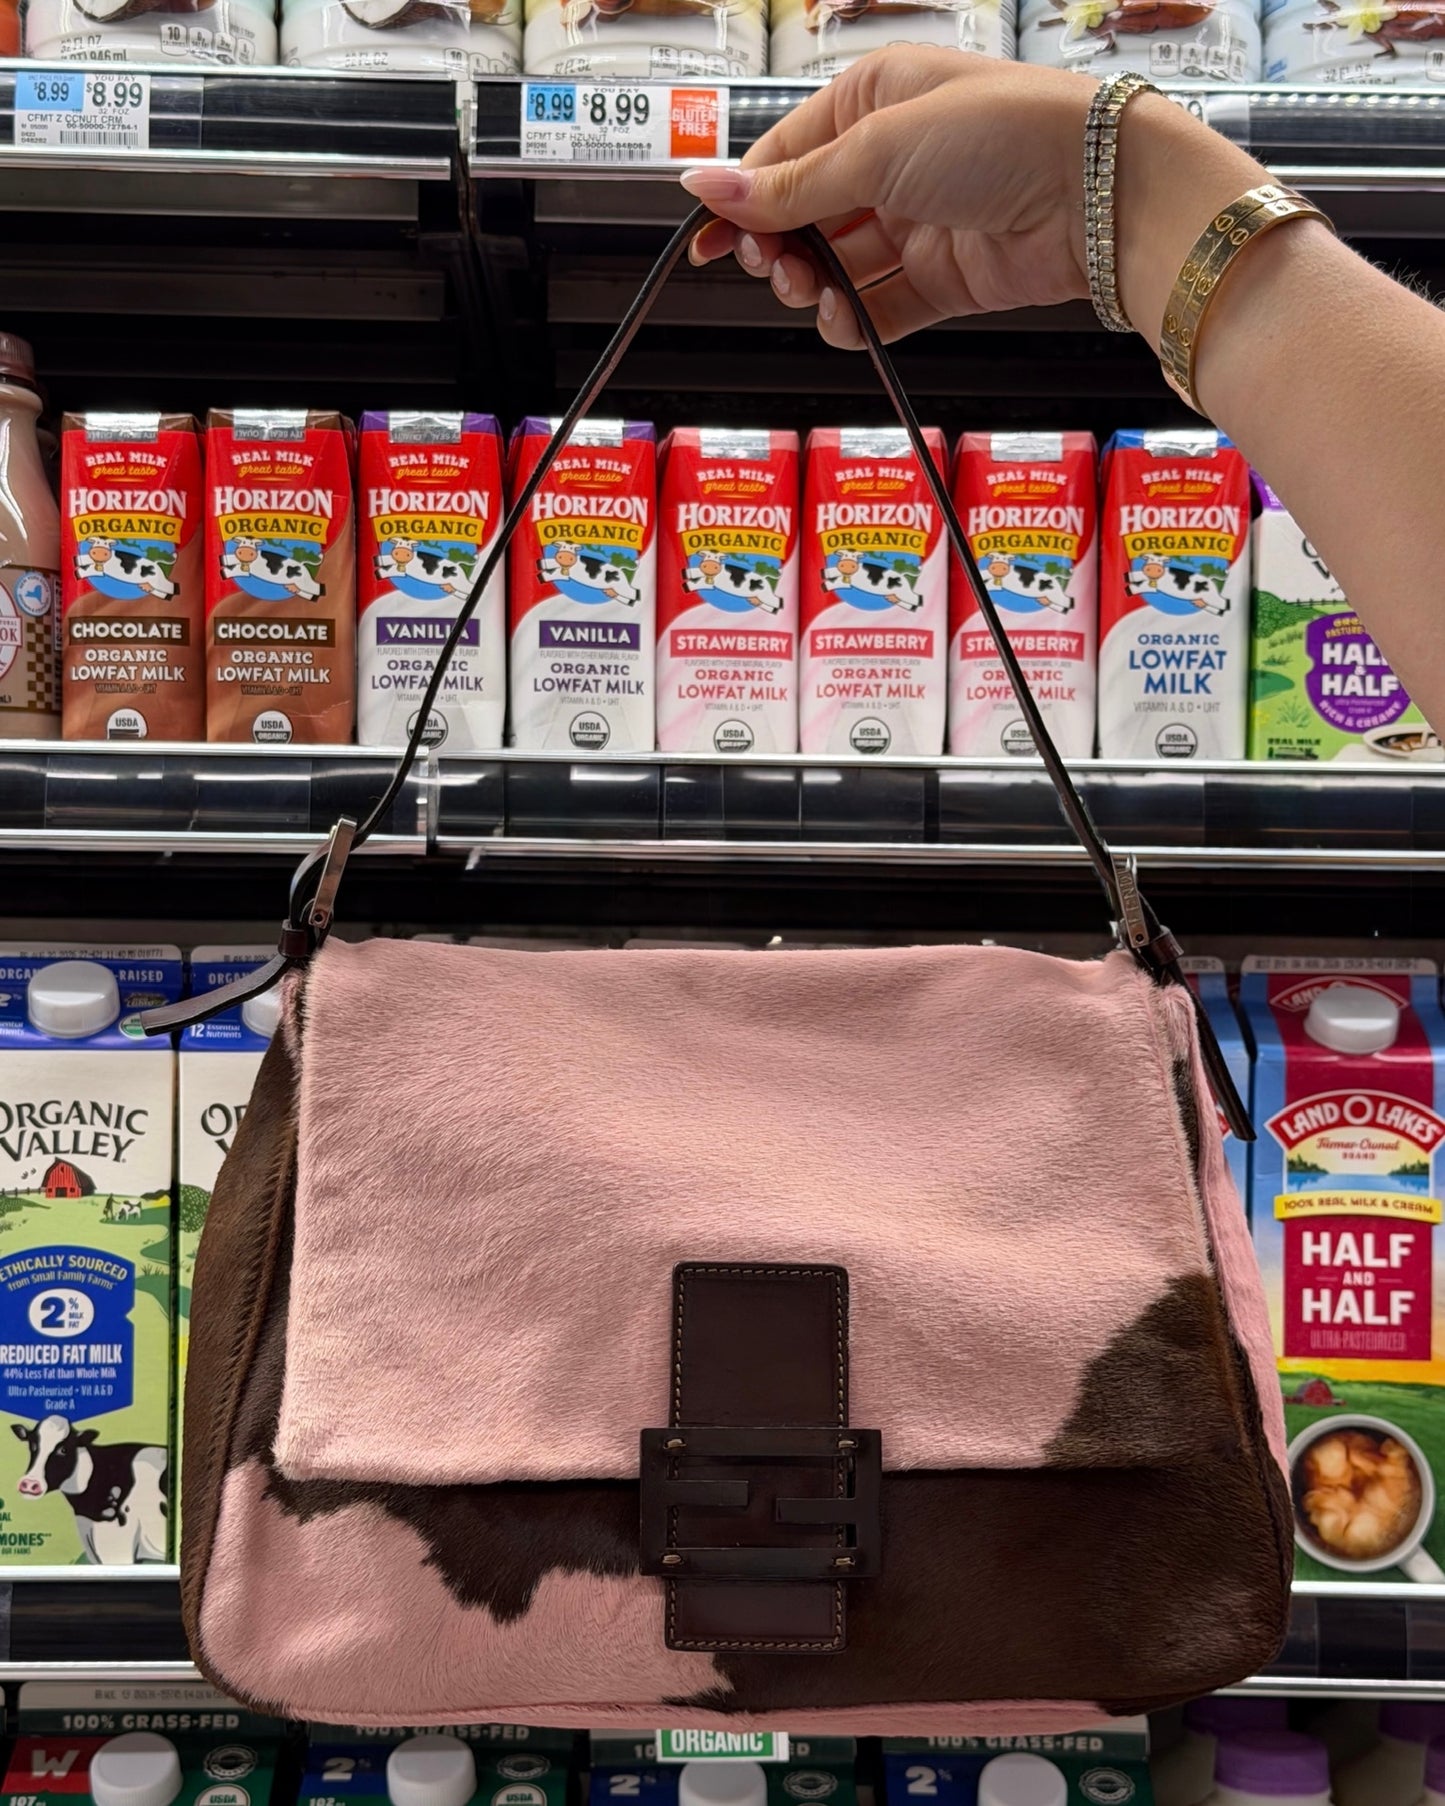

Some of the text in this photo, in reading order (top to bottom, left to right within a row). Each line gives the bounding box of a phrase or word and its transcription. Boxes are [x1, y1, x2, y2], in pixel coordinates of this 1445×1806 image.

[34, 82, 69, 101] $8.99
[86, 82, 143, 108] $8.99
[582, 93, 650, 126] $8.99
[672, 108, 717, 122] GLUTEN
[679, 122, 709, 136] FREE
[85, 451, 168, 467] REAL MILK
[232, 450, 314, 467] REAL MILK
[388, 453, 470, 469] REAL MILK
[552, 458, 632, 475] REAL MILK
[92, 466, 158, 479] great taste
[239, 464, 304, 478] great taste
[396, 467, 460, 480] great taste
[559, 470, 622, 483] great taste
[697, 469, 775, 484] REAL MILK
[835, 466, 916, 482] REAL MILK
[986, 470, 1067, 485] REAL MILK
[1141, 469, 1224, 485] REAL MILK
[703, 481, 766, 494] great taste
[69, 486, 187, 519] HORIZON
[214, 486, 333, 519] HORIZON
[368, 488, 489, 520] HORIZON
[532, 493, 648, 527] HORIZON
[677, 503, 792, 537] HORIZON
[816, 503, 933, 534] HORIZON
[968, 505, 1085, 537] HORIZON
[1119, 504, 1240, 536] HORIZON
[78, 518, 176, 536] ORGANIC
[224, 518, 322, 536] ORGANIC
[379, 519, 478, 537] ORGANIC
[543, 524, 639, 543] ORGANIC
[688, 533, 782, 552] ORGANIC
[827, 531, 922, 549] ORGANIC
[978, 534, 1074, 551] ORGANIC
[1131, 535, 1230, 552] ORGANIC
[72, 622, 182, 639] CHOCOLATE
[218, 624, 328, 640] CHOCOLATE
[550, 626, 631, 643] VANILLA
[677, 635, 788, 652] STRAWBERRY
[815, 634, 928, 651] STRAWBERRY
[966, 635, 1079, 652] STRWBERRY
[1138, 633, 1220, 645] ORGANIC
[85, 649, 167, 662] ORGANIC
[231, 651, 313, 664] ORGANIC
[1129, 650, 1228, 670] LOWFAT
[1322, 643, 1388, 665] HAL
[71, 666, 185, 681] LOWFAT MILK
[387, 660, 468, 671] ORGAIC
[551, 663, 630, 675] ORGANIC
[1354, 665, 1366, 675] &
[217, 667, 331, 683] LOWFAT MILK
[695, 669, 774, 681] ORGANIC
[832, 668, 912, 680] ORGANIC
[982, 670, 1063, 681] ORANIC
[372, 675, 484, 691] LOWFA MILK
[534, 678, 645, 695] LOWFAT MILK
[816, 683, 926, 699] LOWFAT MILK
[1143, 673, 1213, 694] MILK
[1322, 674, 1399, 697] HALF
[678, 684, 788, 701] LOWFAT MILK
[967, 686, 1076, 700] LOWF MILK
[1133, 702, 1167, 713] VITAMIN
[115, 718, 138, 727] USDA
[261, 720, 284, 730] USDA
[579, 722, 601, 731] USDA
[723, 729, 745, 738] USDA
[859, 727, 882, 737] USDA
[1165, 734, 1188, 743] USDA
[190, 1024, 205, 1037] 12
[1280, 1095, 1439, 1144] LAND O LAKES
[0, 1129, 135, 1163] VALLEY
[1342, 1152, 1376, 1160] BRAND
[1284, 1200, 1313, 1210] 100%
[1318, 1199, 1346, 1207] REAL
[1351, 1199, 1377, 1208] MILK
[1392, 1200, 1433, 1213] CREAM
[1302, 1231, 1415, 1268] HALF
[0, 1255, 128, 1281] ETHICALLY SOURCED
[7, 1270, 114, 1292] from Small Family Farms
[1343, 1271, 1375, 1286] AND
[1302, 1288, 1415, 1326] HALF
[0, 1344, 122, 1364] REDUCED FAT MILK
[4, 1367, 117, 1379] 44% Less Fat than Whole Milk
[8, 1386, 27, 1396] Ultra
[29, 1385, 73, 1396] Pasteurized
[45, 1399, 75, 1410] Grade A
[63, 1714, 114, 1729] 100%
[671, 1730, 763, 1752] ORGANIC
[32, 1749, 79, 1777] W
[210, 1794, 237, 1804] USDA
[506, 1794, 533, 1804] USDA
